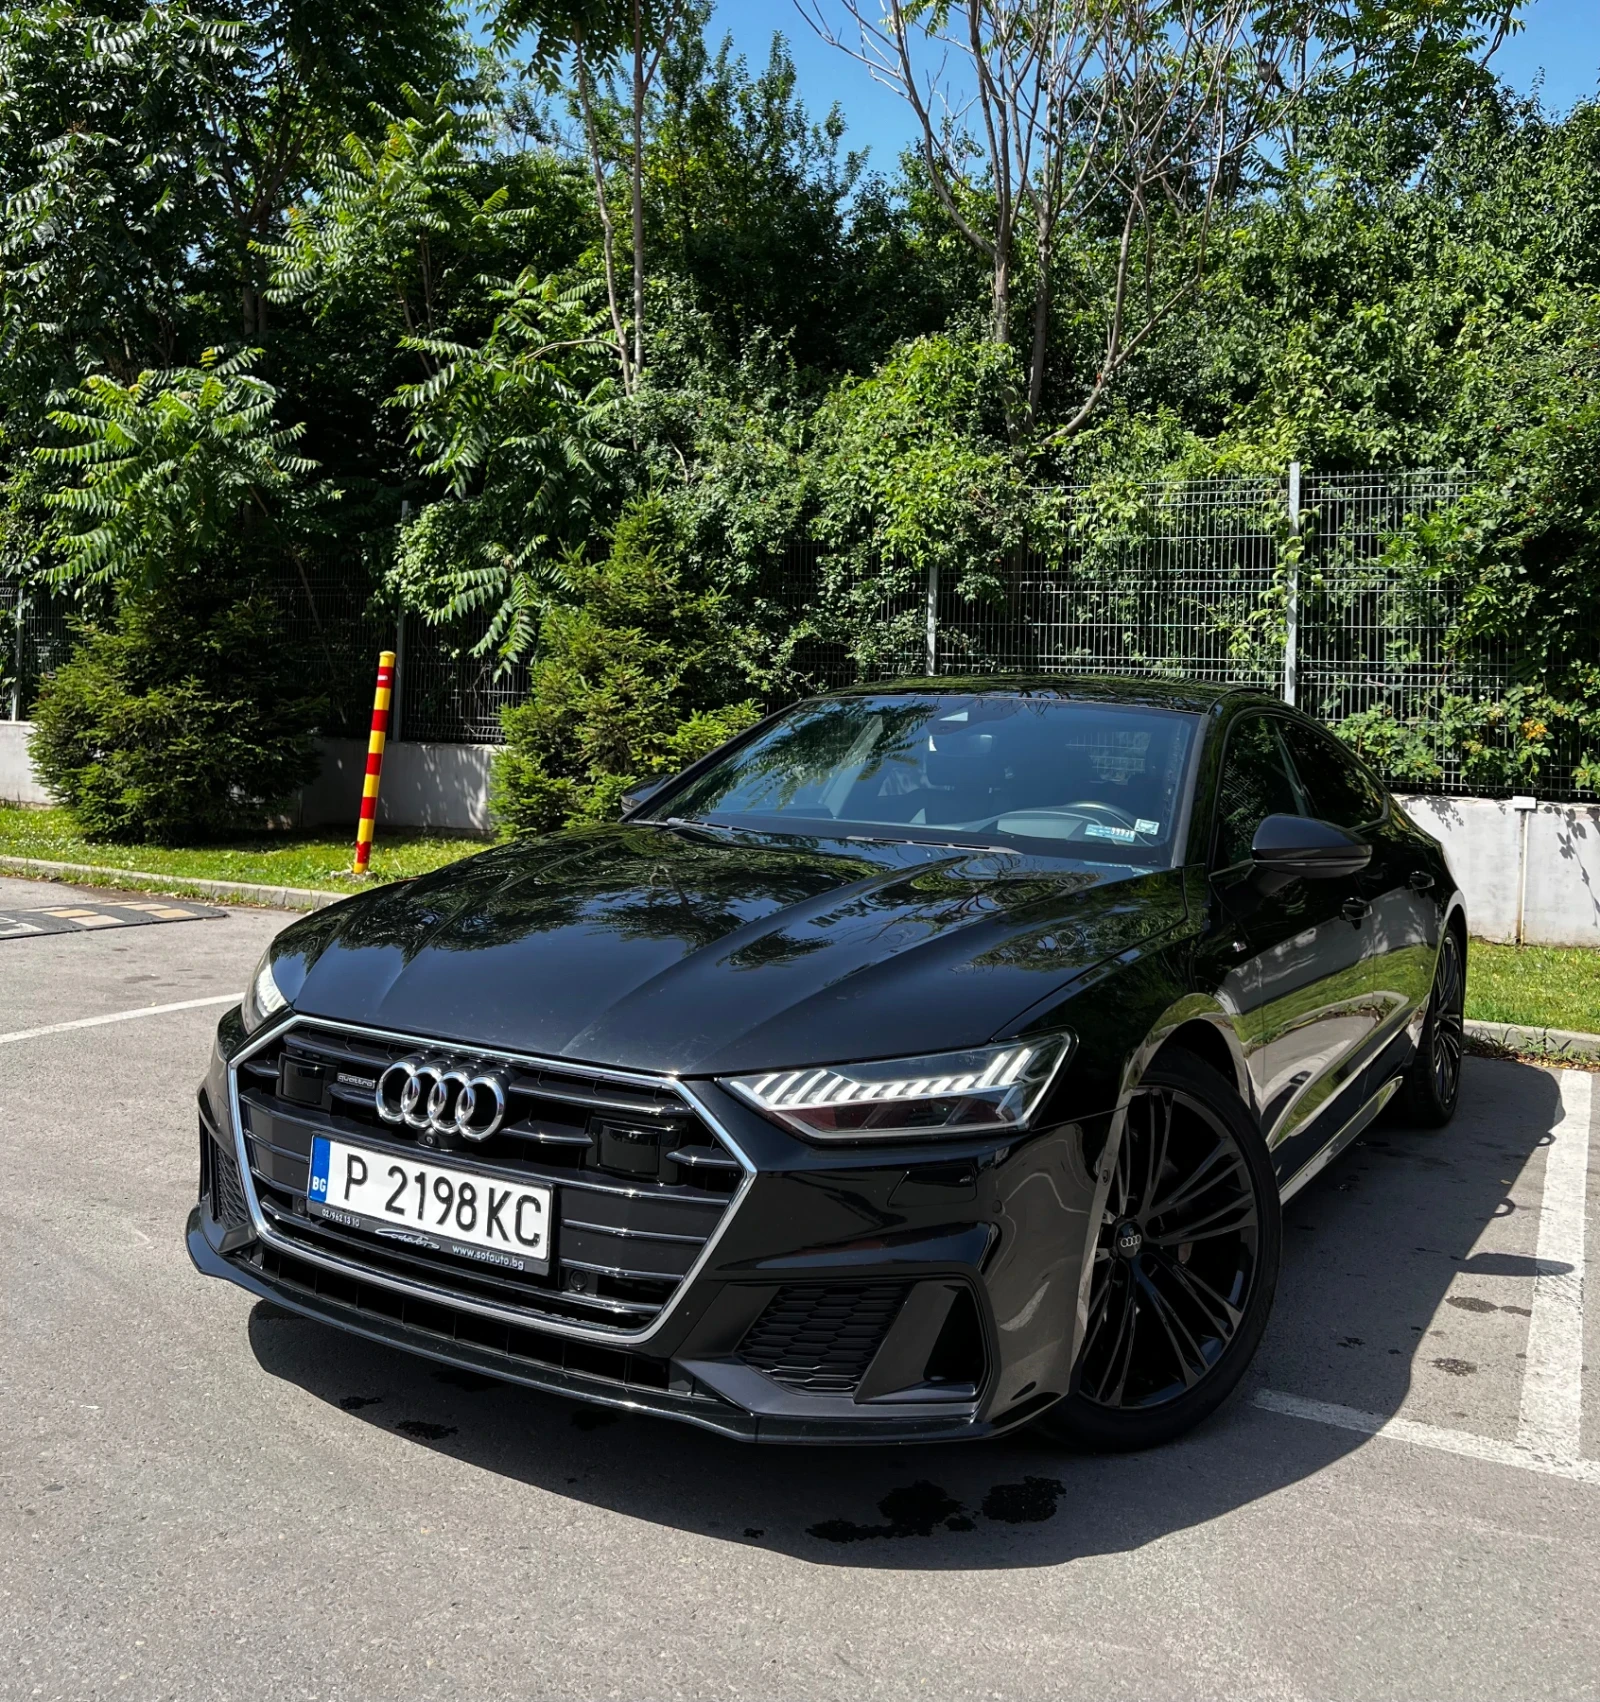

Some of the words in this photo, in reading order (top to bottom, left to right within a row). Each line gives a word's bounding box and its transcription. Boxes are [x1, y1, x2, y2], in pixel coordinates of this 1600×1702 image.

[338, 1075, 373, 1087] quattro
[312, 1176, 327, 1192] BG
[344, 1153, 368, 1201] P
[452, 1244, 524, 1271] www.sofauto.bg
